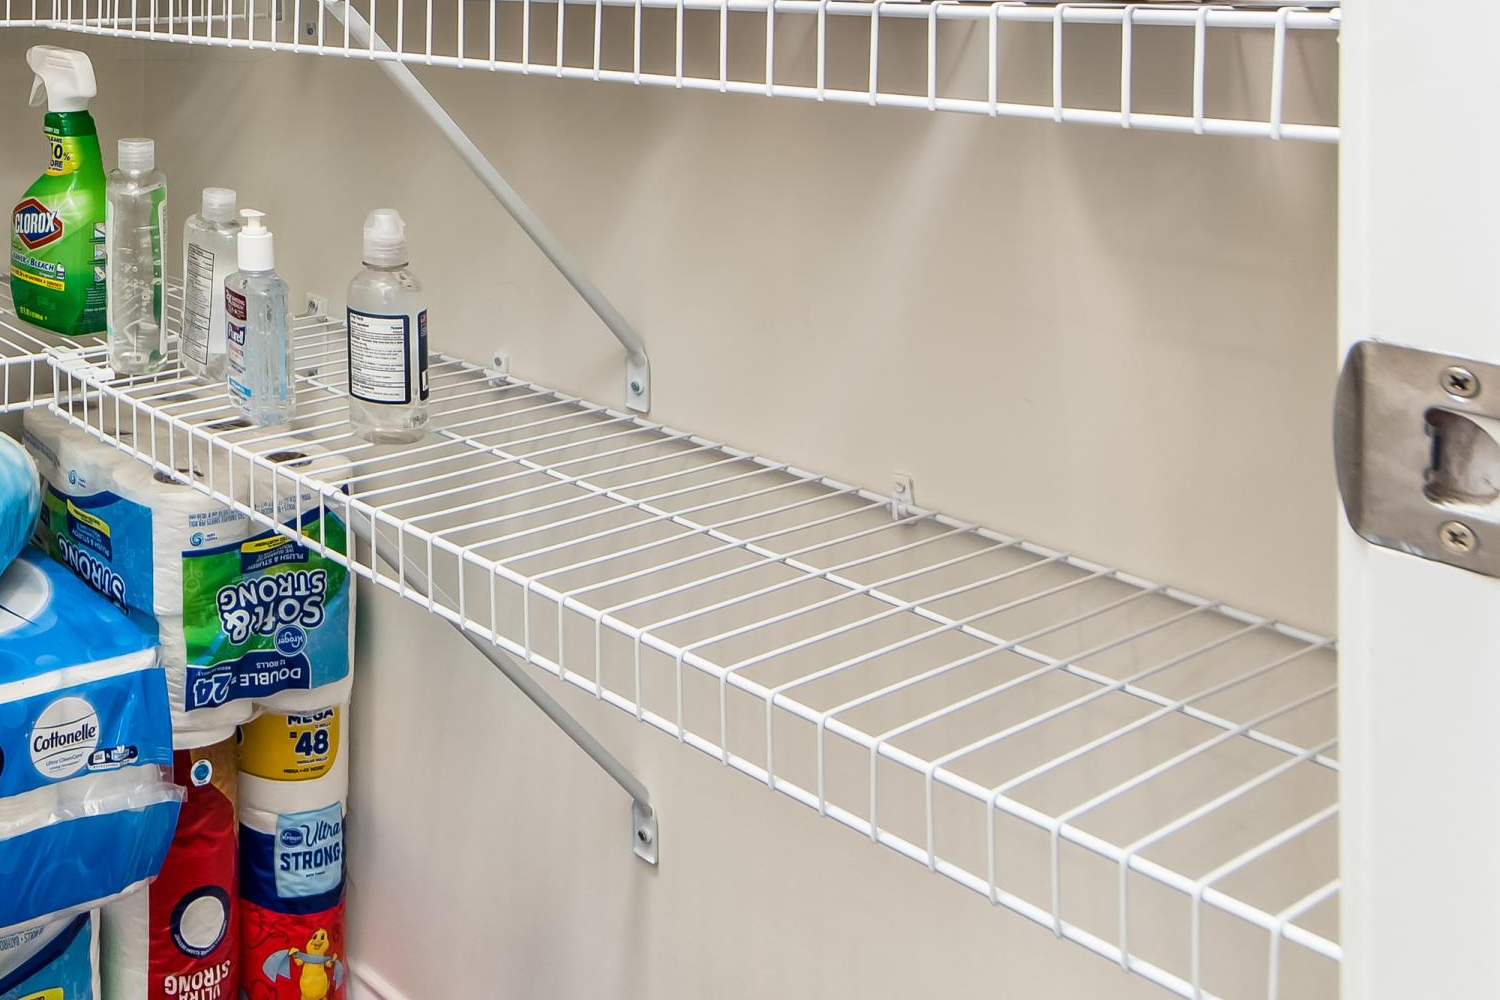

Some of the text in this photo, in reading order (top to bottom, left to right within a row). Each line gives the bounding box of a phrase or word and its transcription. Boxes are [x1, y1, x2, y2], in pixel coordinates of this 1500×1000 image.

[14, 210, 58, 235] CLOROX
[218, 570, 326, 611] STRONG
[194, 673, 232, 707] 24
[239, 667, 301, 687] DOUBLE
[33, 723, 97, 753] Cottonelle
[295, 729, 330, 756] 48
[302, 820, 341, 848] Ultra
[280, 842, 341, 872] STRONG
[164, 960, 231, 995] STRONG
